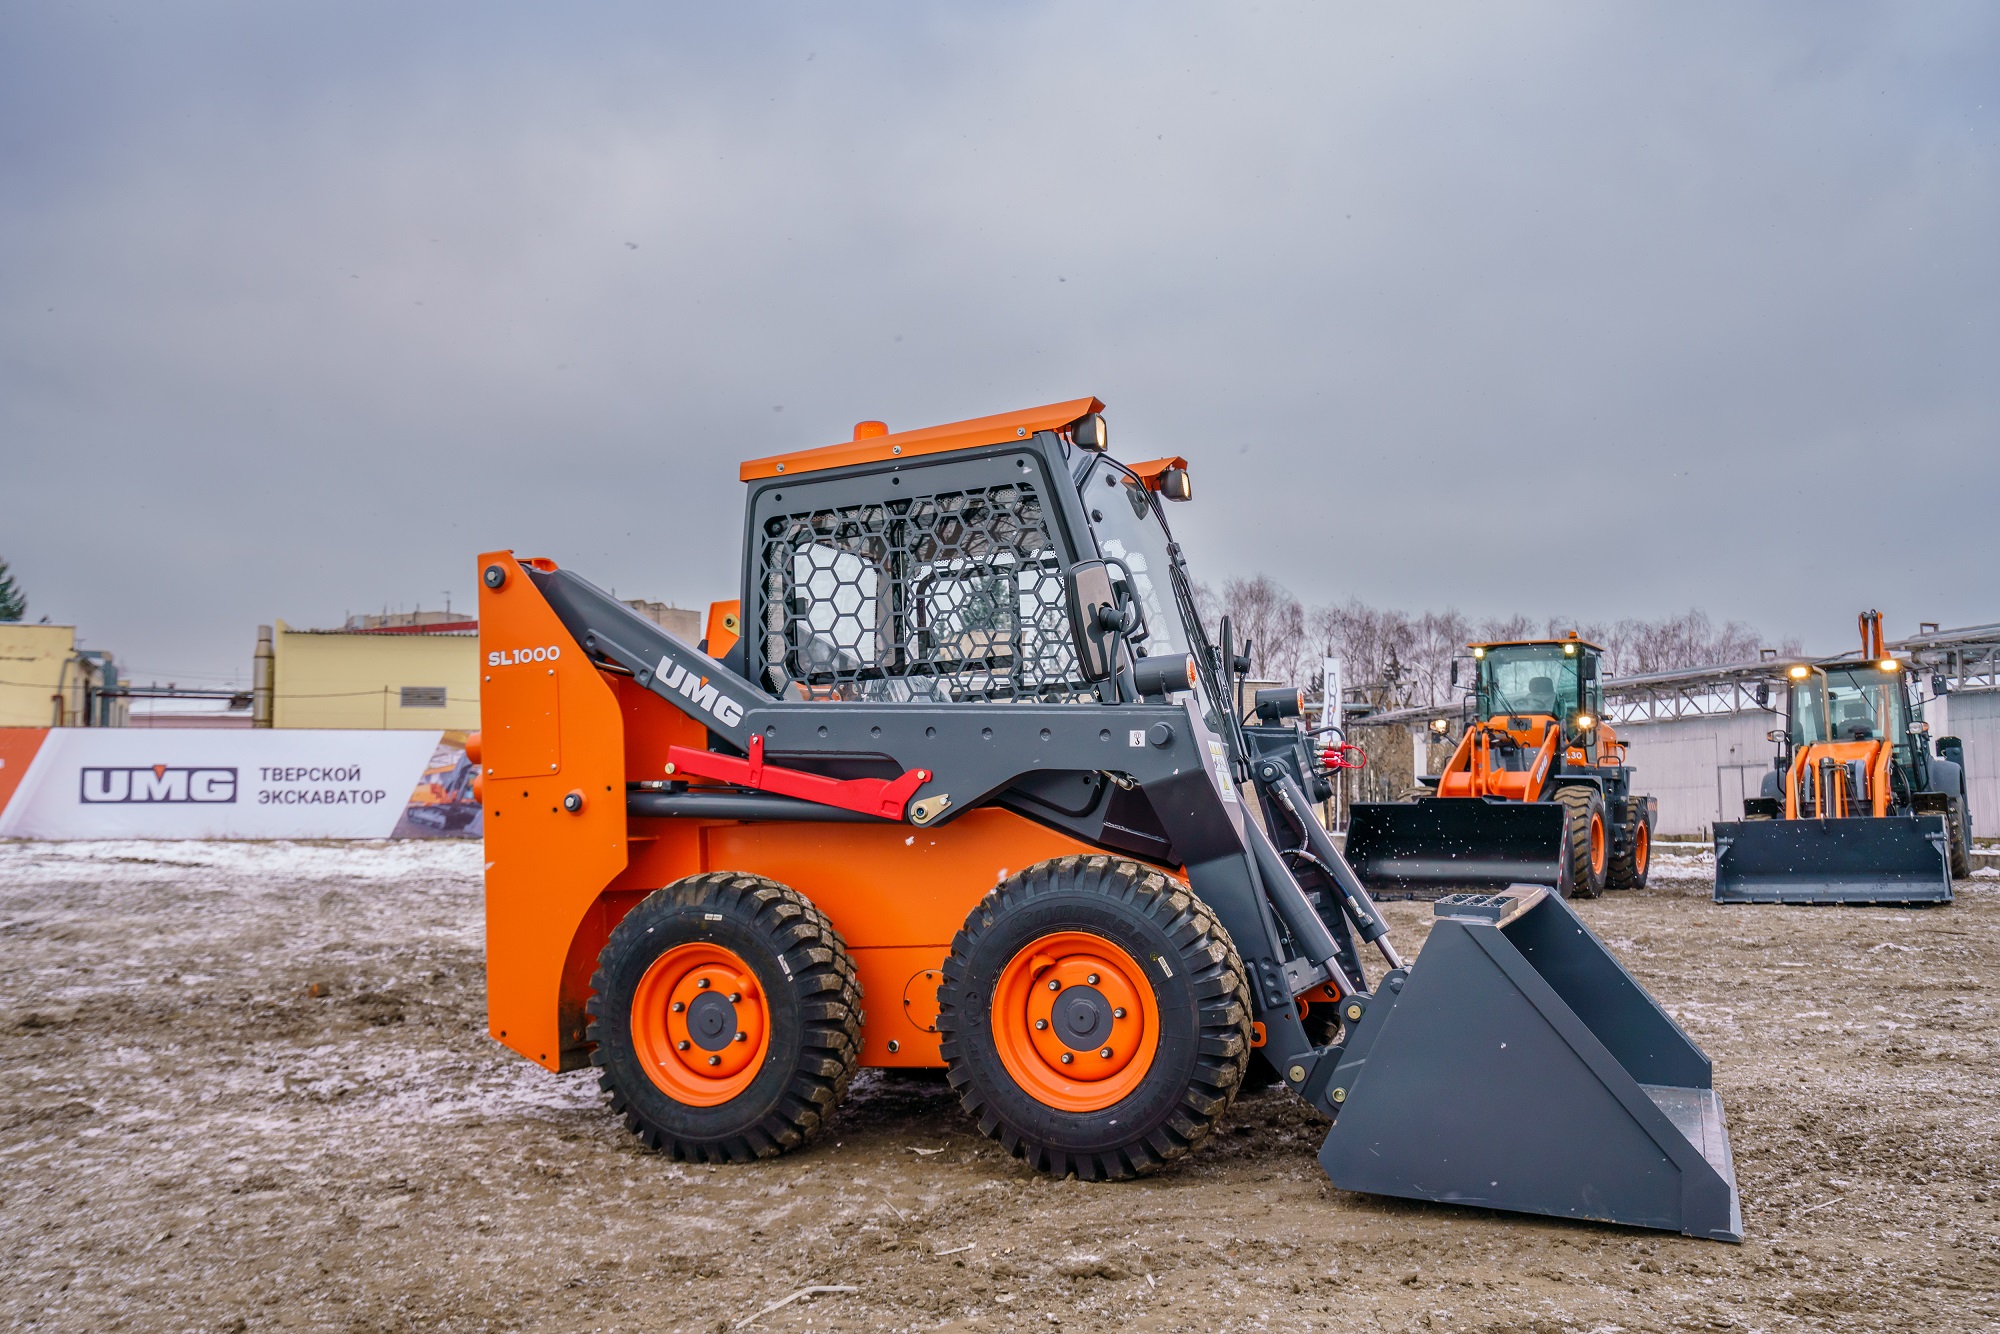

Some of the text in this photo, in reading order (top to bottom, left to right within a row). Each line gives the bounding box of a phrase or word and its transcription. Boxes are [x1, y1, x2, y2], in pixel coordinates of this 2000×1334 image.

[488, 645, 560, 667] SL1000
[655, 655, 744, 728] UMG
[259, 764, 362, 782] ТВЕРСКОЙ
[82, 766, 237, 803] UMG
[258, 789, 386, 805] ЭКСКАВАТОР
